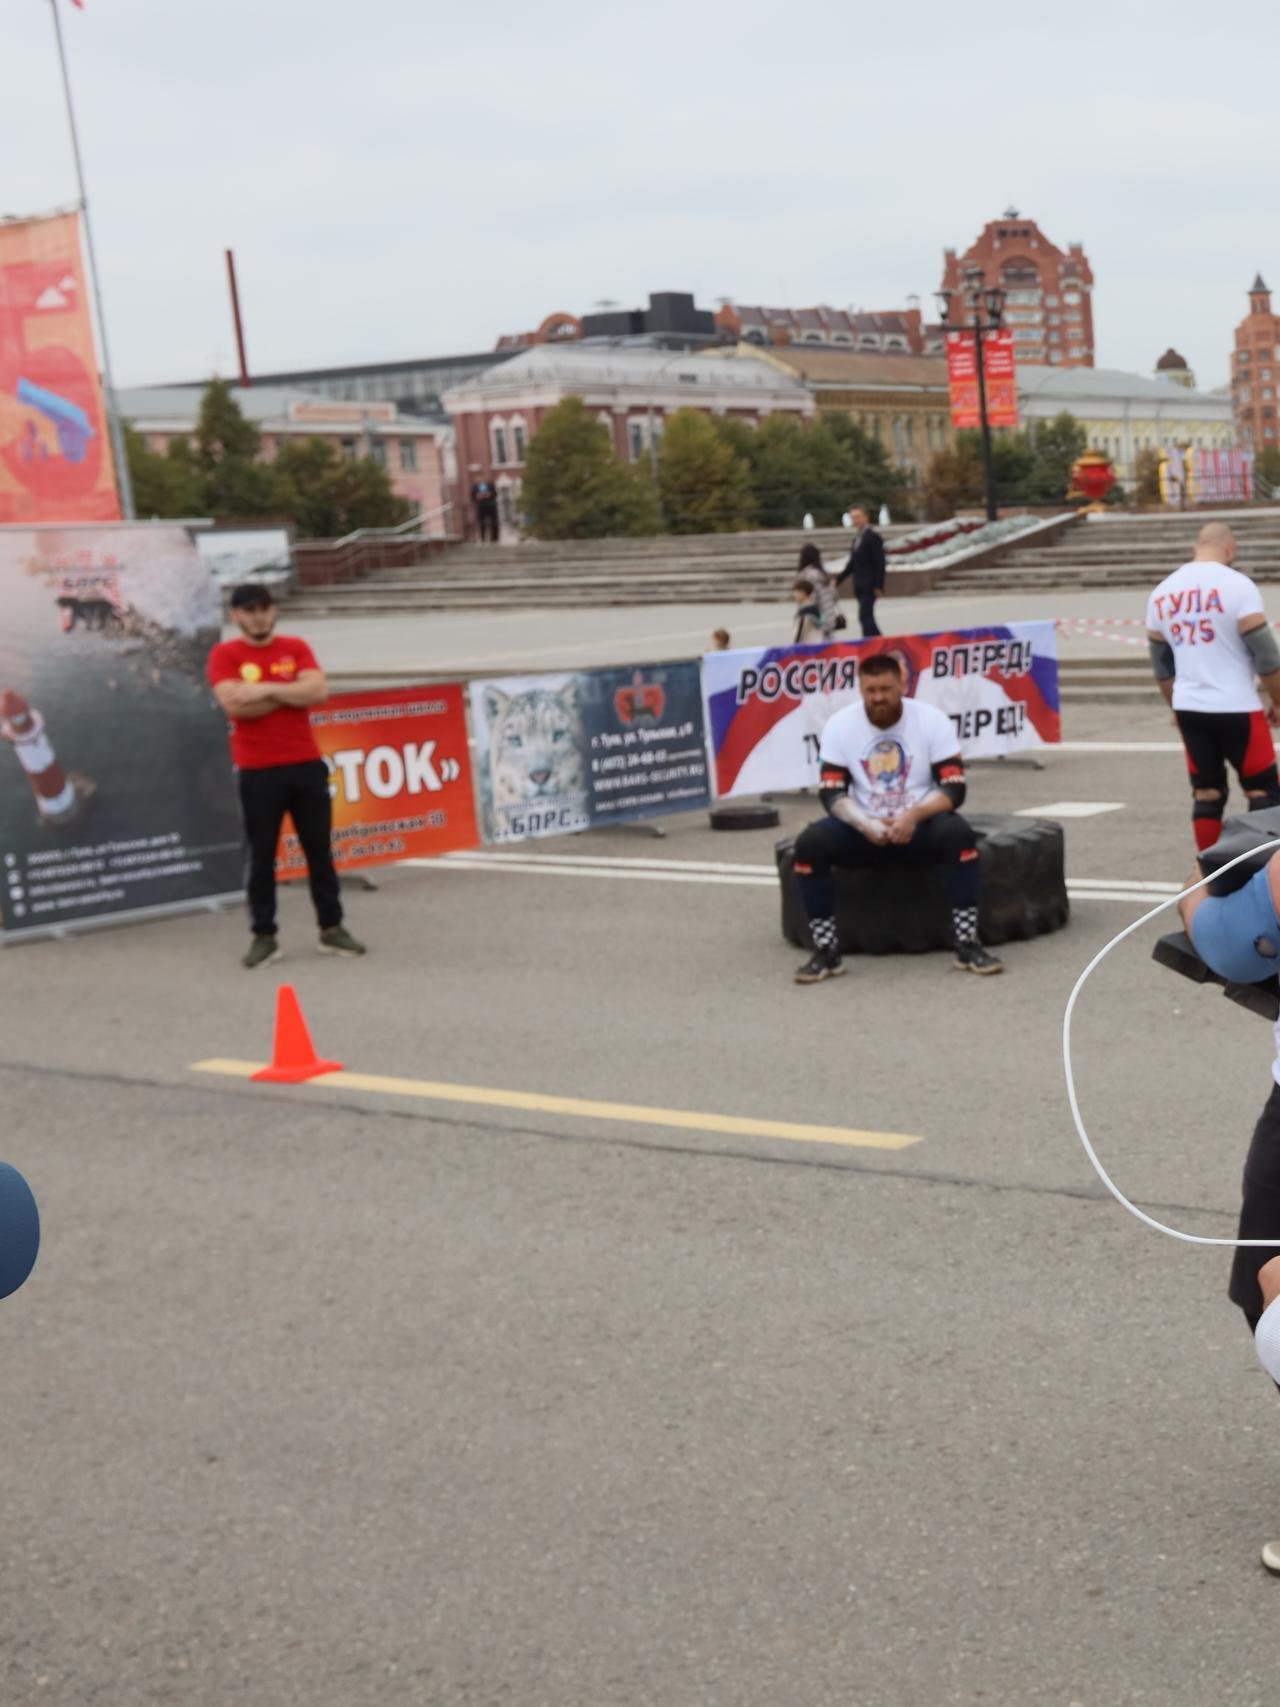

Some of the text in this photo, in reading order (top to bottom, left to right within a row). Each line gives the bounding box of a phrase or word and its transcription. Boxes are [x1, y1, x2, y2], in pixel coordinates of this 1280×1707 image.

[1154, 588, 1224, 620] ТУЛА
[738, 658, 857, 701] РОССИЯ
[948, 705, 1024, 739] ПЕРЕД!
